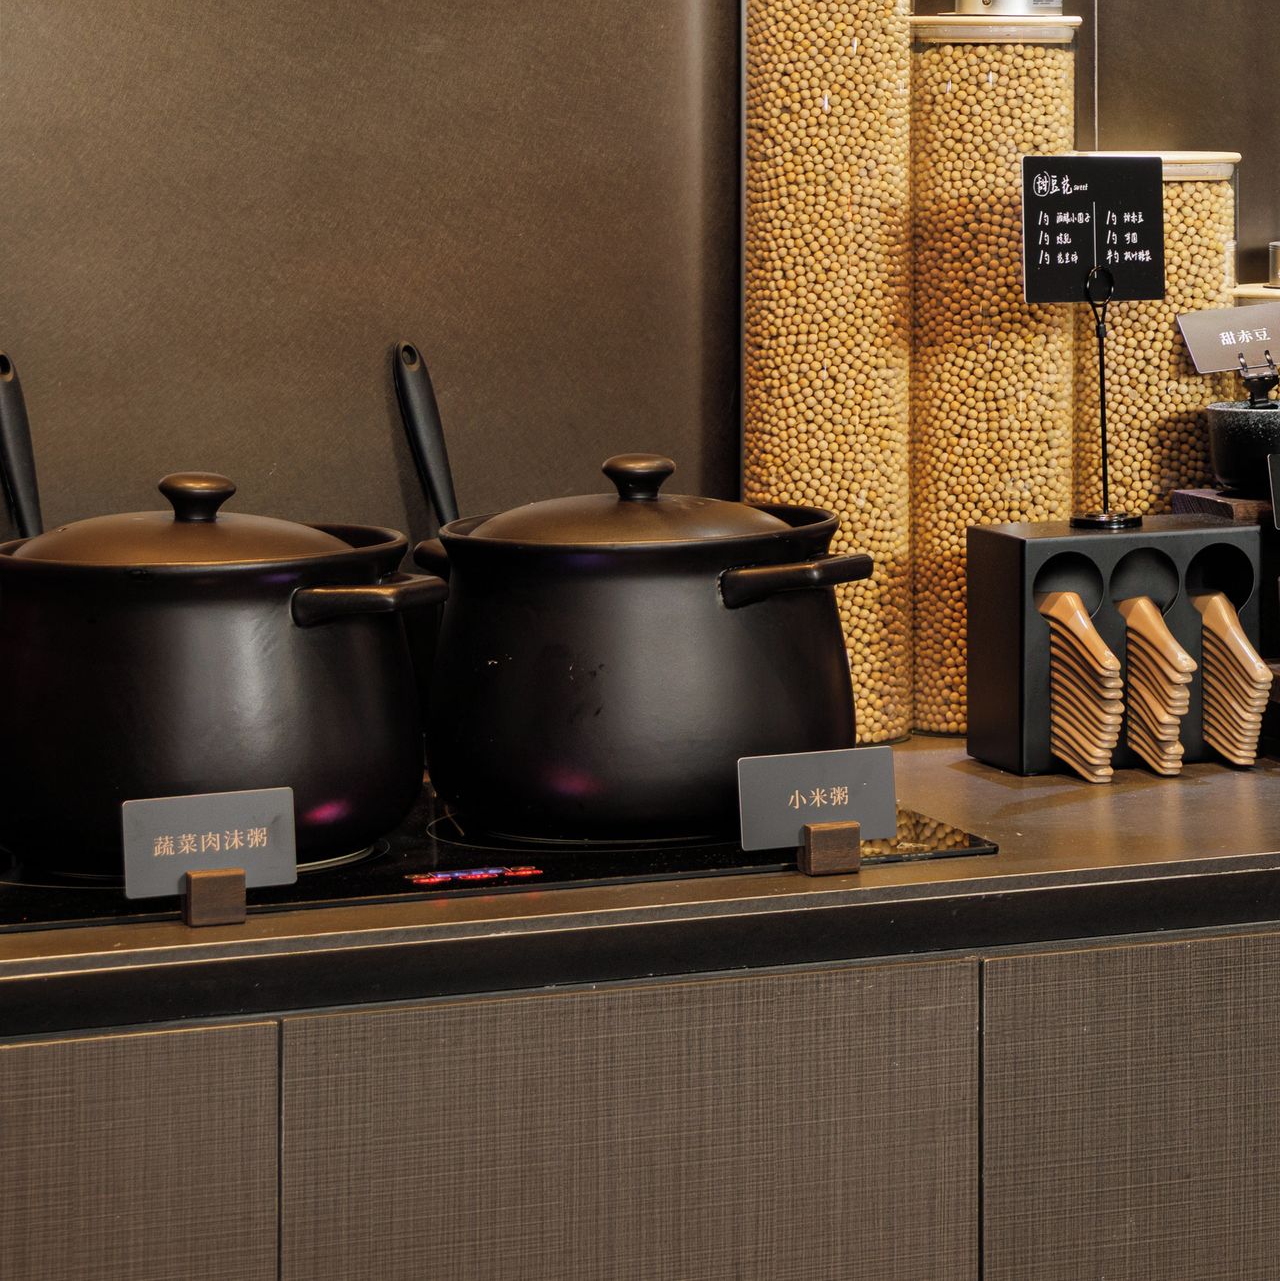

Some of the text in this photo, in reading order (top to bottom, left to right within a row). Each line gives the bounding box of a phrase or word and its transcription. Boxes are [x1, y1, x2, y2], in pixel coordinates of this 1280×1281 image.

[1036, 174, 1073, 195] 甜豆花
[1219, 327, 1271, 347] 甜赤豆
[787, 785, 849, 809] 小米粥
[153, 826, 268, 857] 蔬菜肉沫粥
